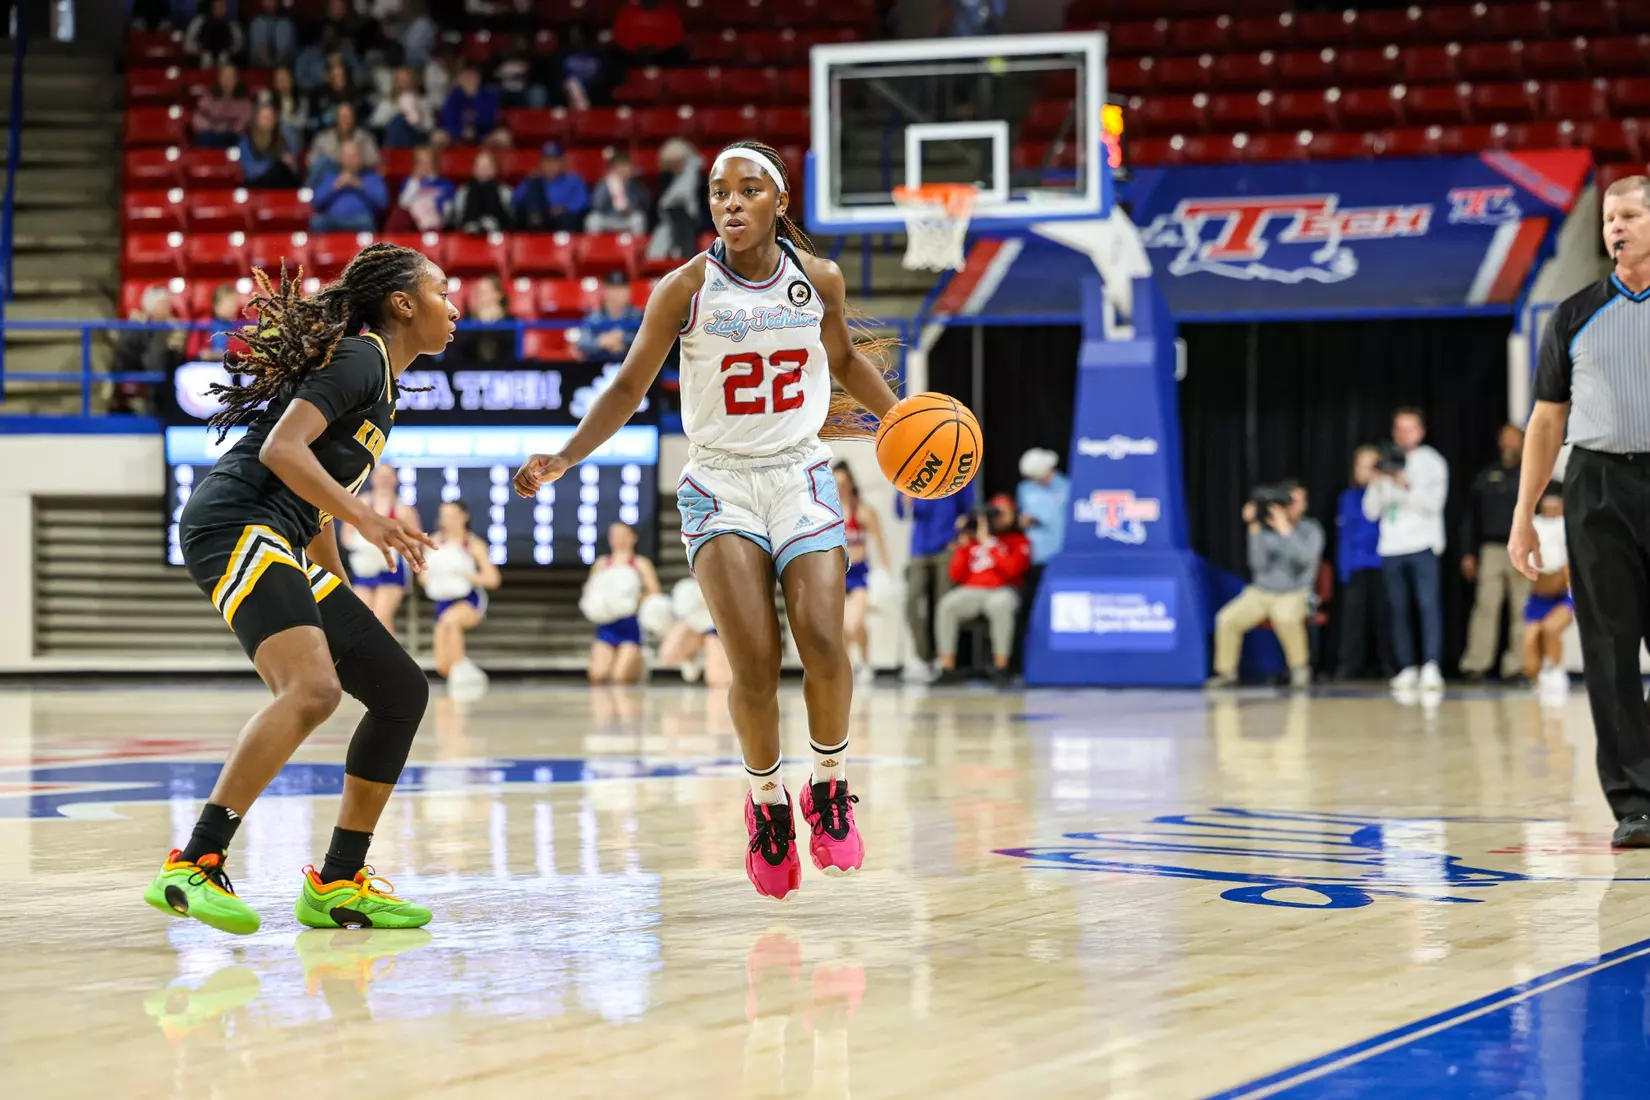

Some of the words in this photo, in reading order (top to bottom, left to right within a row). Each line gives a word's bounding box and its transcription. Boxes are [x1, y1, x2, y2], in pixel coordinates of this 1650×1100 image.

[704, 309, 749, 342] Lady
[721, 349, 808, 415] 22
[906, 453, 944, 494] NCAA
